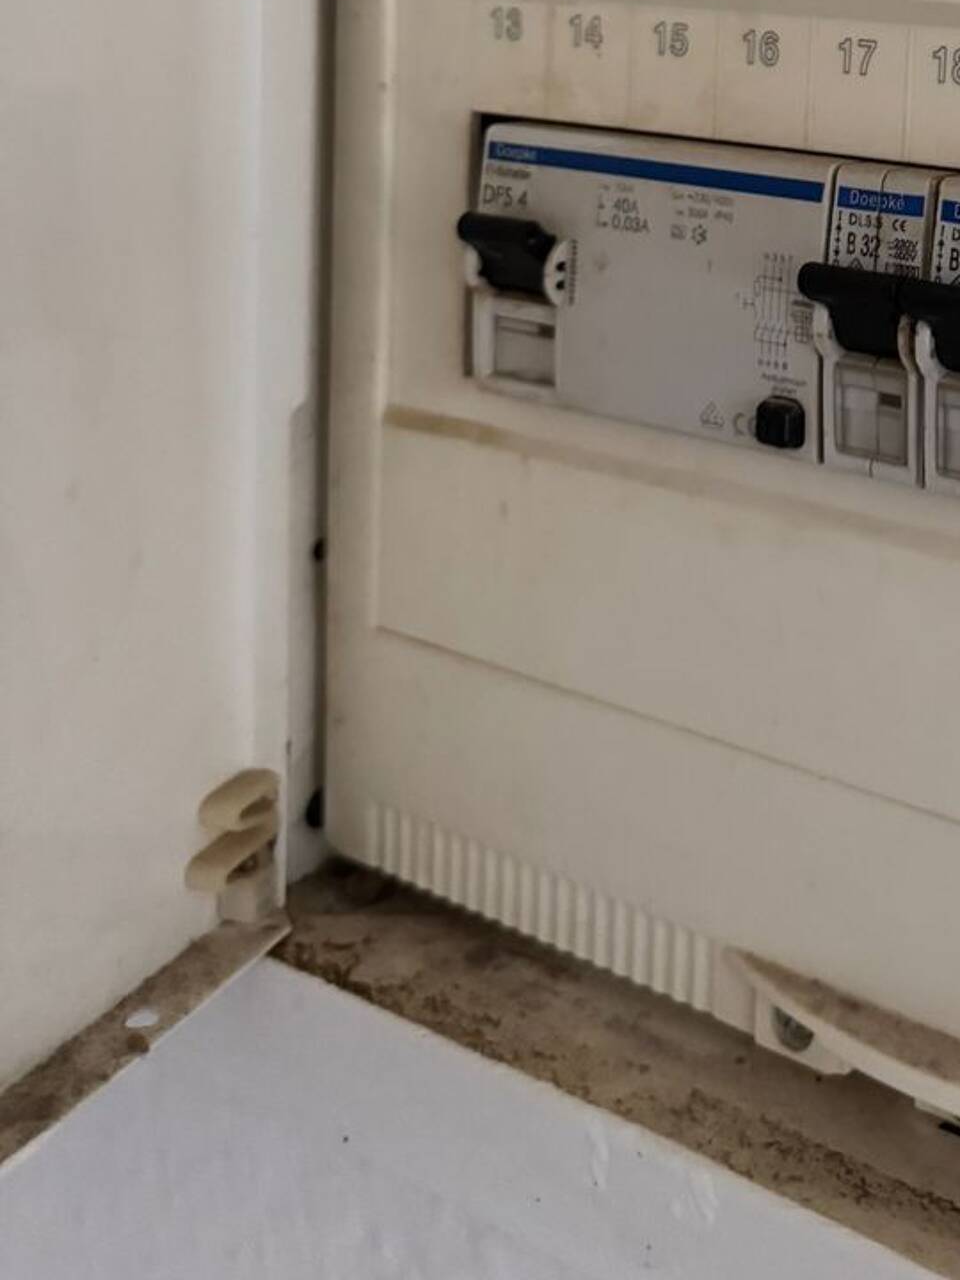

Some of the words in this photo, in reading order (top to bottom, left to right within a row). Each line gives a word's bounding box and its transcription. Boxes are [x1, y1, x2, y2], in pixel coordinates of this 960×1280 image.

[568, 14, 604, 51] 14
[653, 21, 690, 58] 15
[742, 29, 781, 66] 16
[838, 37, 878, 76] 17
[849, 189, 905, 209] Doepke
[847, 231, 856, 255] B
[860, 233, 880, 258] 32
[949, 247, 960, 272] B
